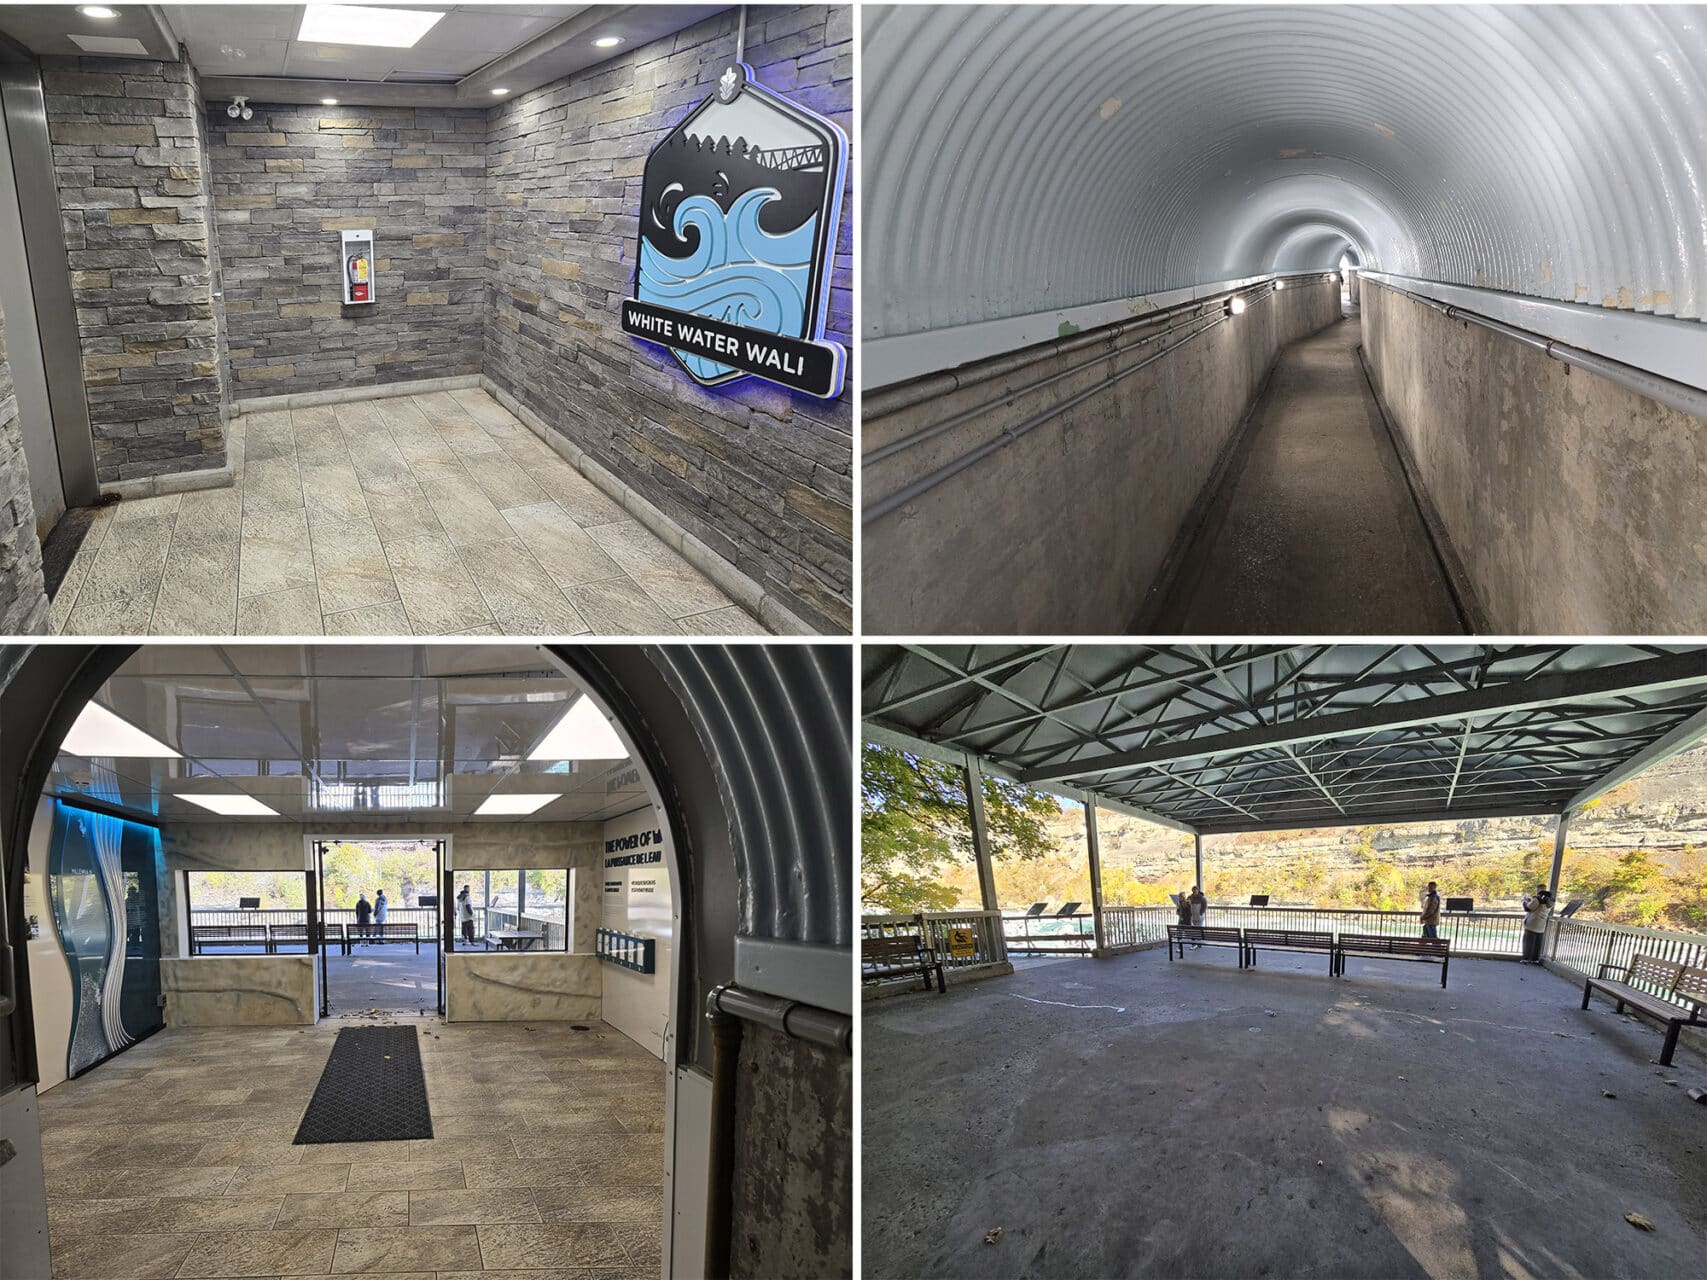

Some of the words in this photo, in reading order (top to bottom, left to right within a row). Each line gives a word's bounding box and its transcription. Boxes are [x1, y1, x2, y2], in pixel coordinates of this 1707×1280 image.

[628, 310, 673, 337] WHITE
[678, 323, 740, 357] WATER
[639, 830, 651, 847] OF
